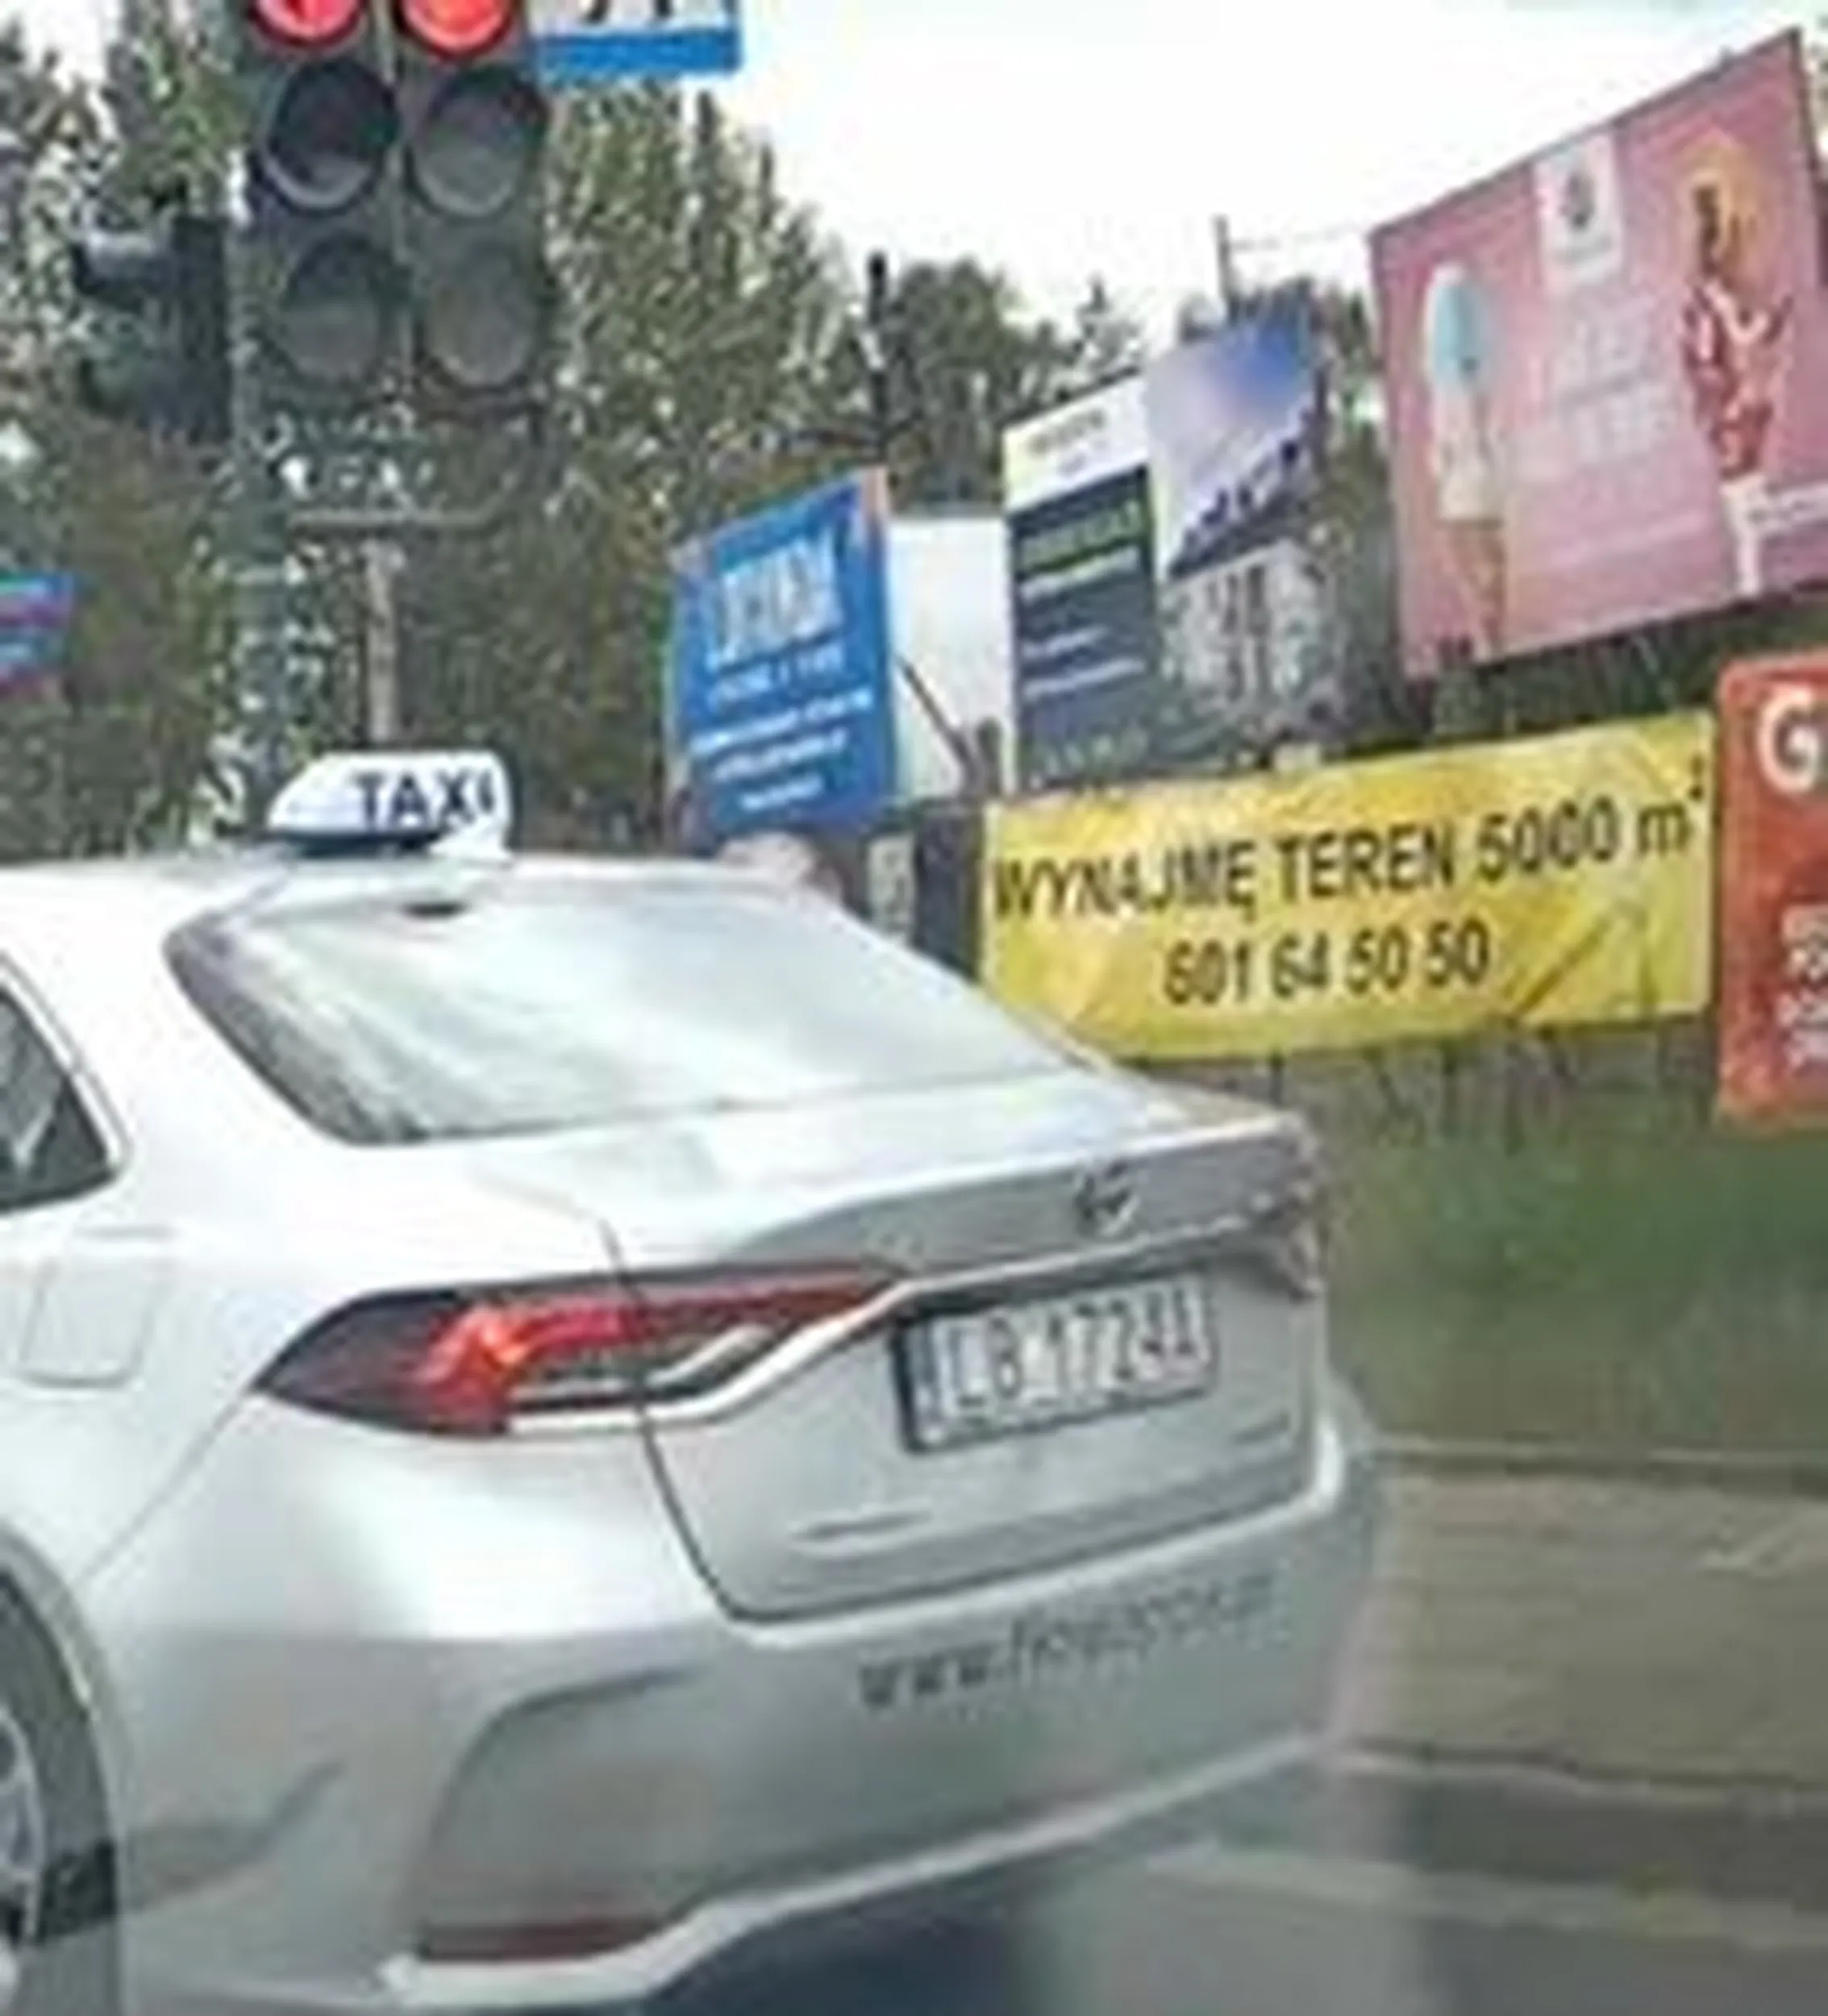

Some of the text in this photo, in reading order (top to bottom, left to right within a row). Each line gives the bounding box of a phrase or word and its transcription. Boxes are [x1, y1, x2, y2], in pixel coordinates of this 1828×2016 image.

[359, 766, 495, 832] TAXI
[994, 839, 1256, 923] WYNAJMĘ
[1276, 817, 1454, 902] TEREN
[1475, 797, 1618, 885] 5000
[1163, 918, 1490, 1005] 601 64 50 50
